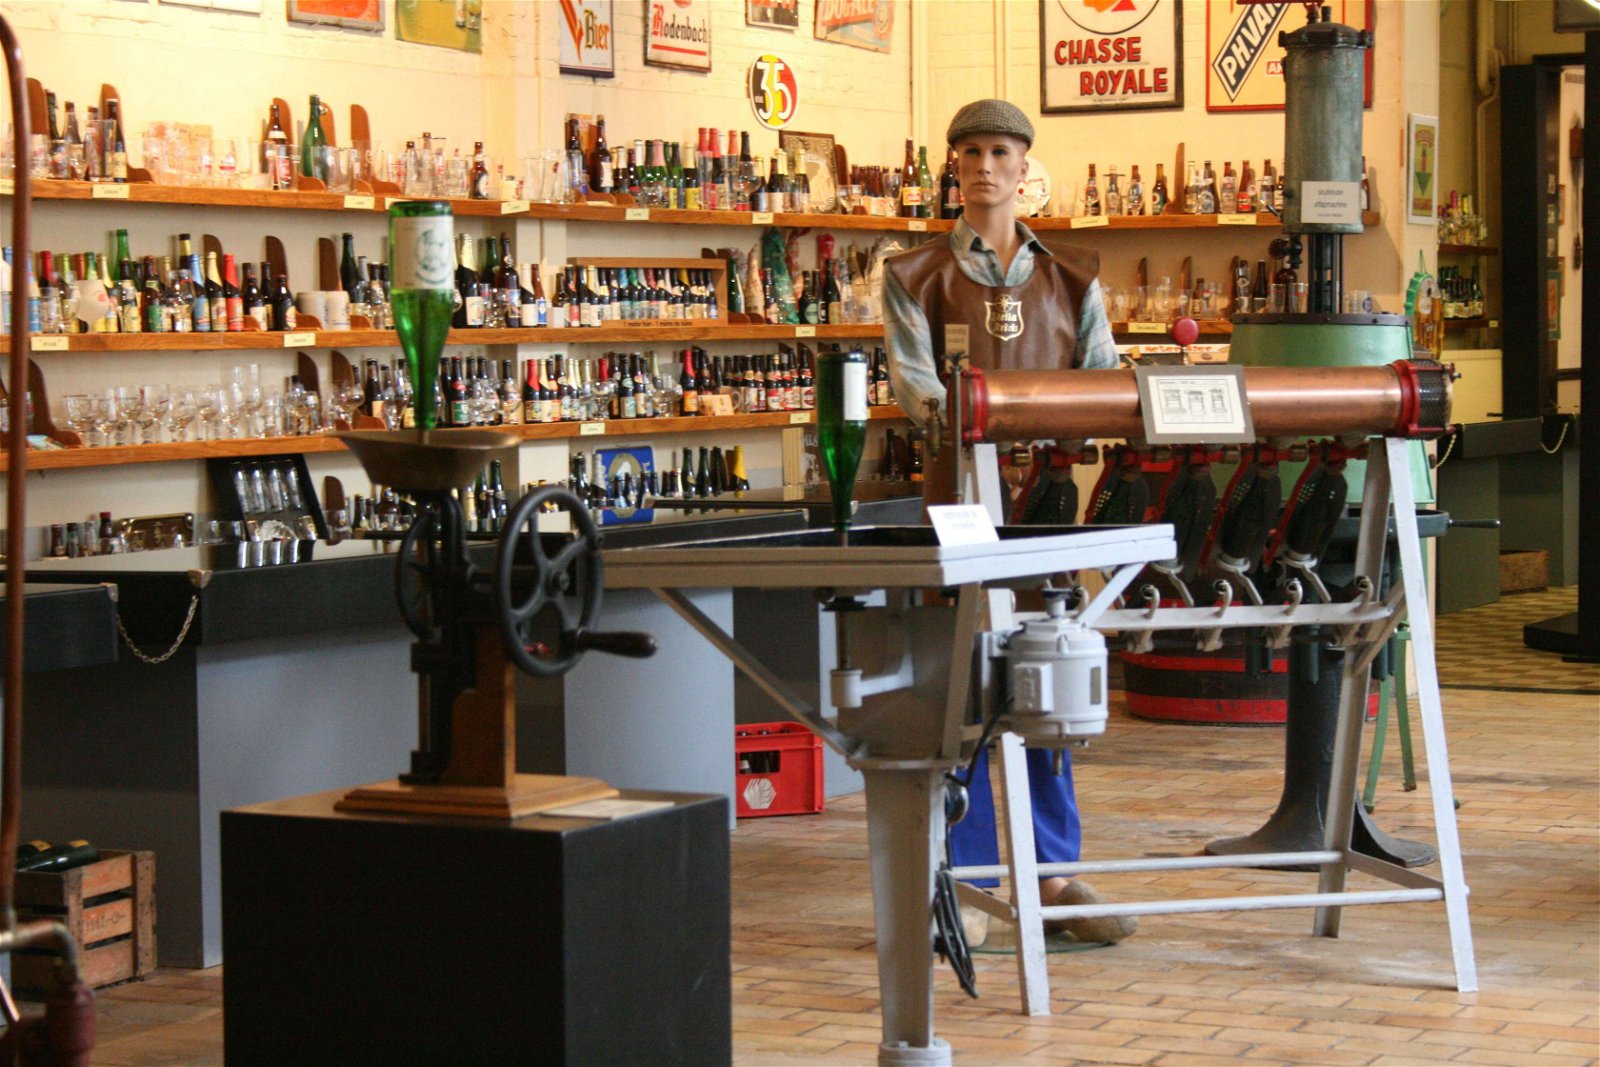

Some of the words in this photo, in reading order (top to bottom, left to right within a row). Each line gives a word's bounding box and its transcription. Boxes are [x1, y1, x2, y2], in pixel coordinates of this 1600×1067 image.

[583, 9, 609, 50] Bier
[651, 3, 708, 43] Rodenbach
[1054, 36, 1142, 65] CHASSE
[756, 61, 792, 120] 35
[1080, 67, 1168, 96] ROYALE
